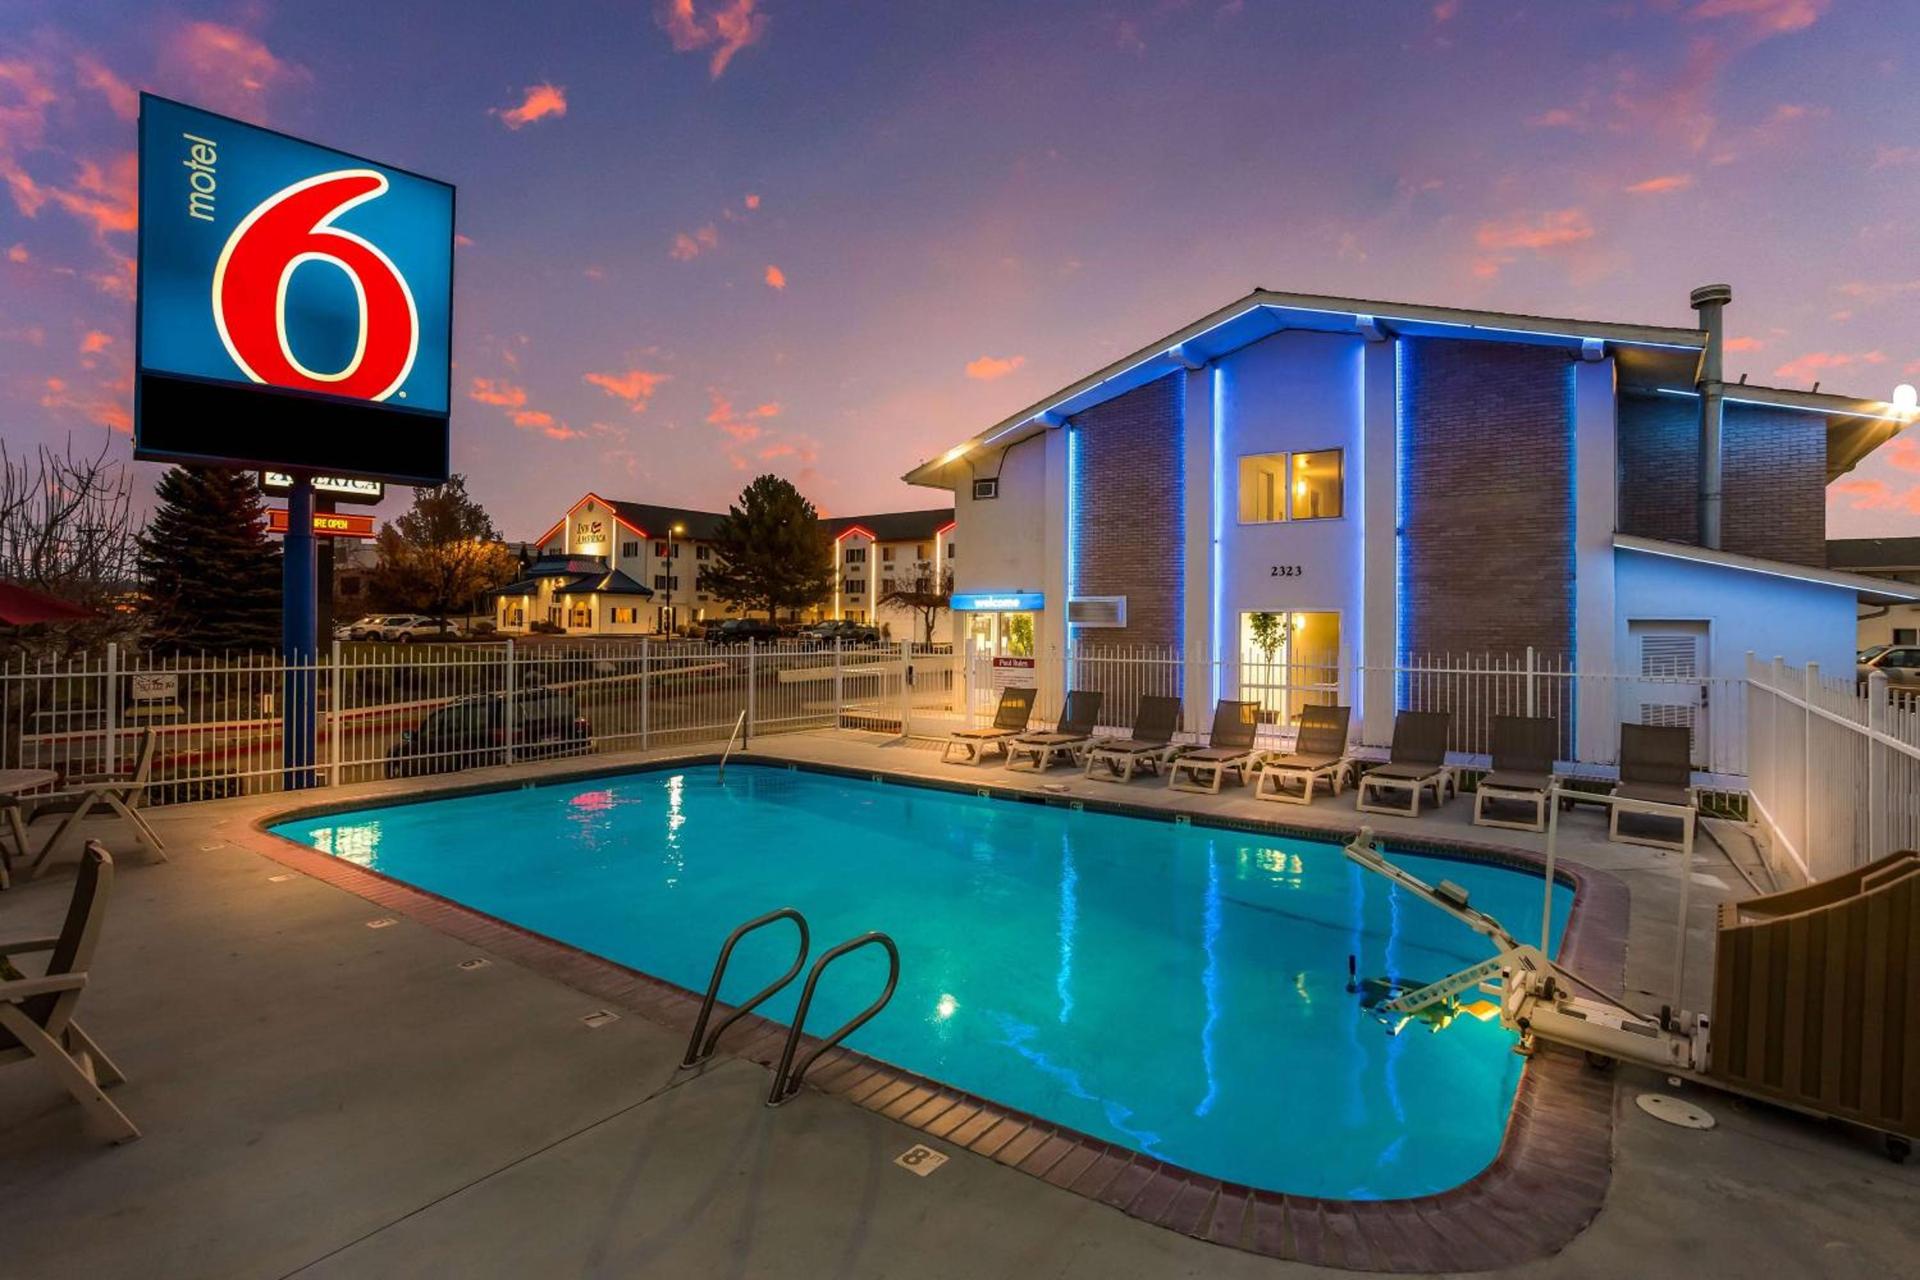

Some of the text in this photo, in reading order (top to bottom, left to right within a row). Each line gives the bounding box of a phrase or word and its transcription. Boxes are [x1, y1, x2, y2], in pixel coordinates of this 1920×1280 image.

[183, 132, 217, 222] motel
[212, 168, 419, 402] 6
[328, 519, 348, 529] OPEN
[1271, 566, 1302, 576] 2323
[902, 1148, 930, 1165] 8
